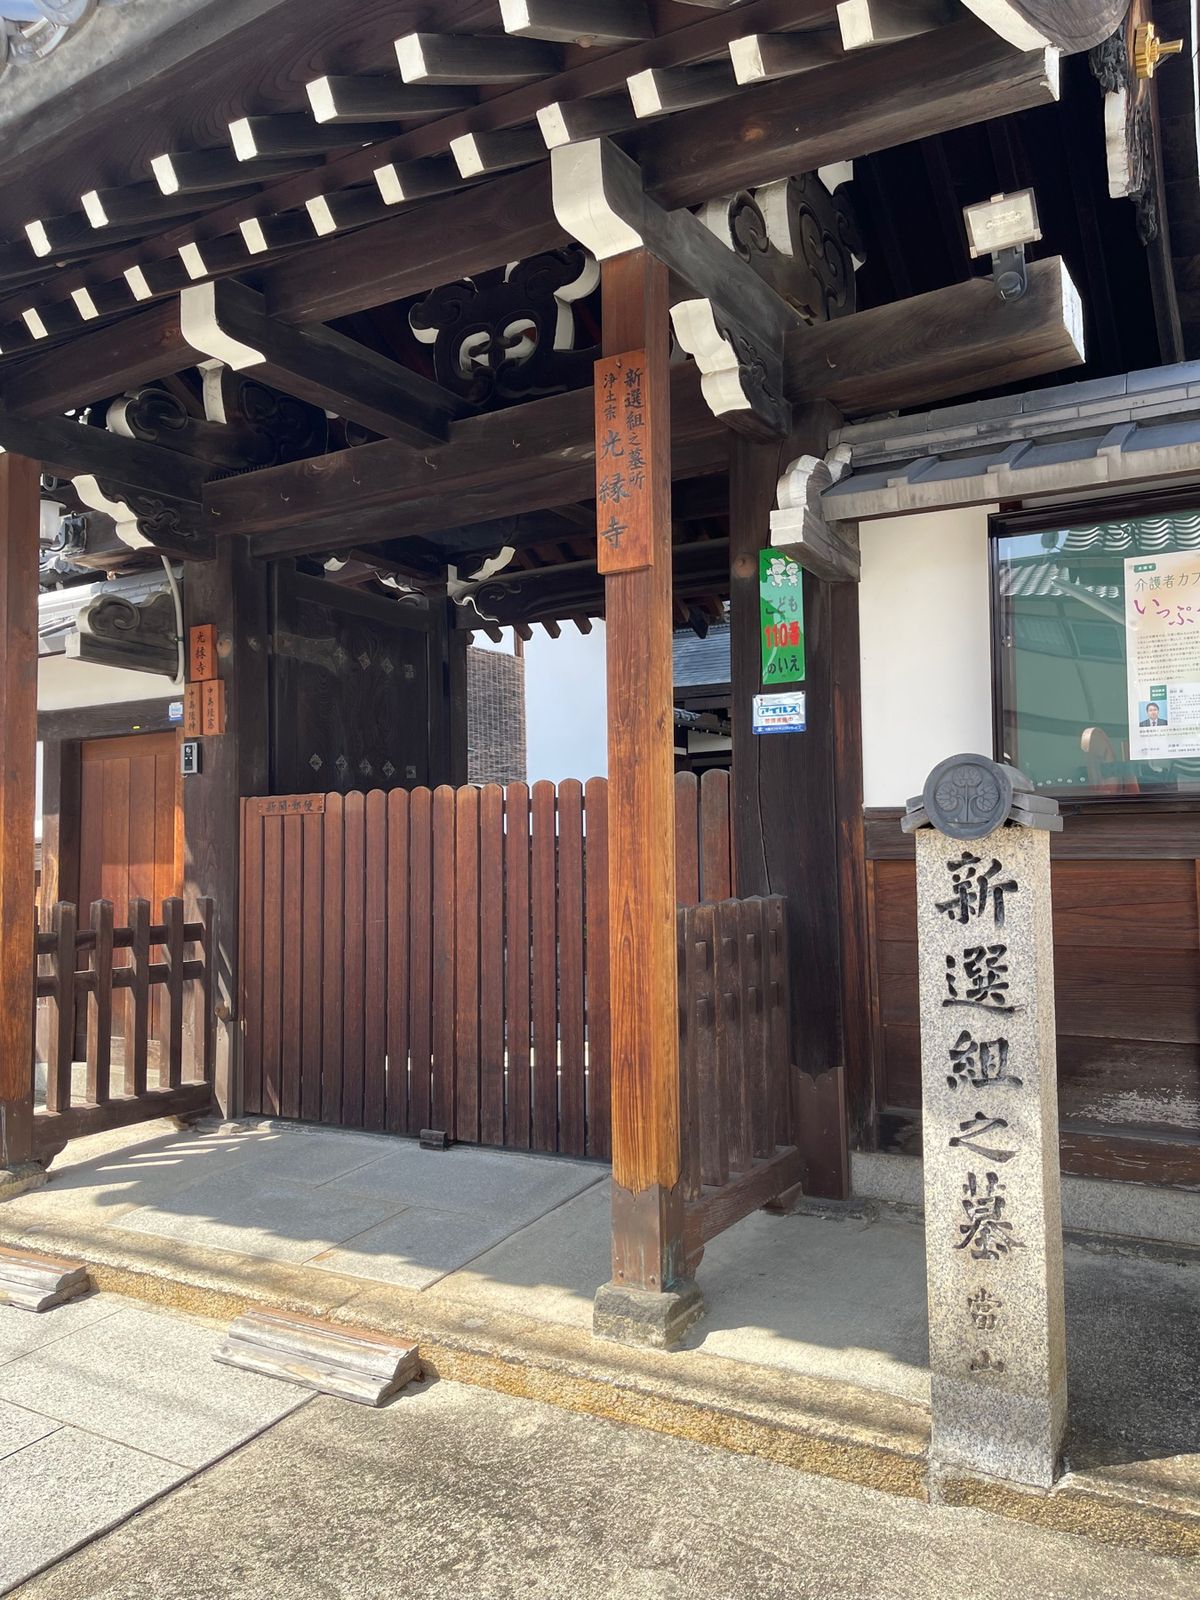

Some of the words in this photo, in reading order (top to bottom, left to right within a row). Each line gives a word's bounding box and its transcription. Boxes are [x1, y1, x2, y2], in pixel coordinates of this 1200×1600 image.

[603, 373, 618, 422] 浄土宗
[624, 367, 647, 490] 新選組之墓所
[599, 430, 631, 549] 光縁寺
[765, 596, 798, 625] こども
[1133, 598, 1200, 626] いっぷ
[765, 621, 799, 648] 110番
[767, 655, 800, 674] のいえ
[759, 705, 798, 715] アイルス
[934, 850, 1027, 1260] 新選組之墓
[966, 1285, 1005, 1375] 當山
